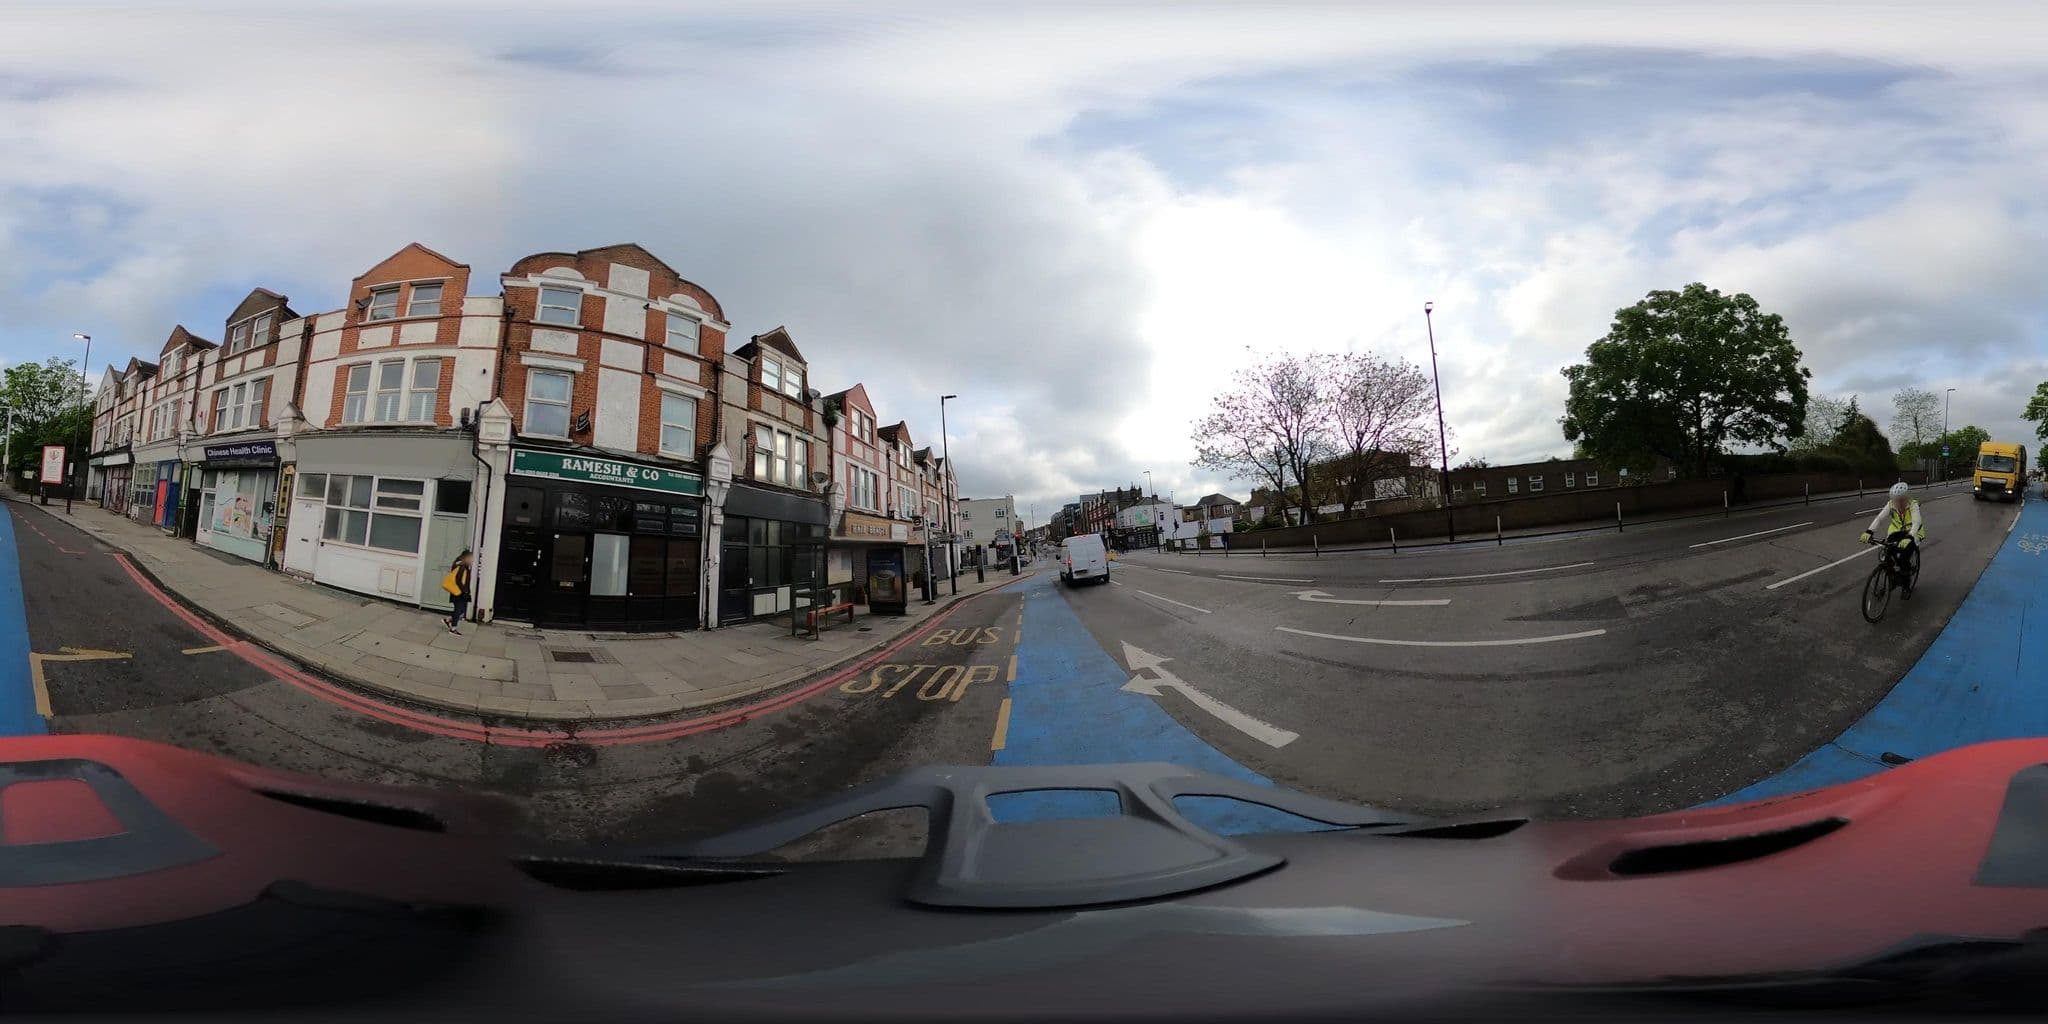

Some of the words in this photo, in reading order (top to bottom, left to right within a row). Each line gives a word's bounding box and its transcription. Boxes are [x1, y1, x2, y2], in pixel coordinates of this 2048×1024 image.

[207, 448, 229, 457] Chinese
[230, 446, 251, 455] Health
[251, 445, 272, 454] Clinic
[562, 458, 622, 476] RAMESH
[626, 466, 638, 478] &
[642, 469, 660, 481] CO
[589, 473, 635, 484] ACCOUNTANTS
[921, 626, 1005, 647] BUS
[839, 664, 999, 702] STOP
